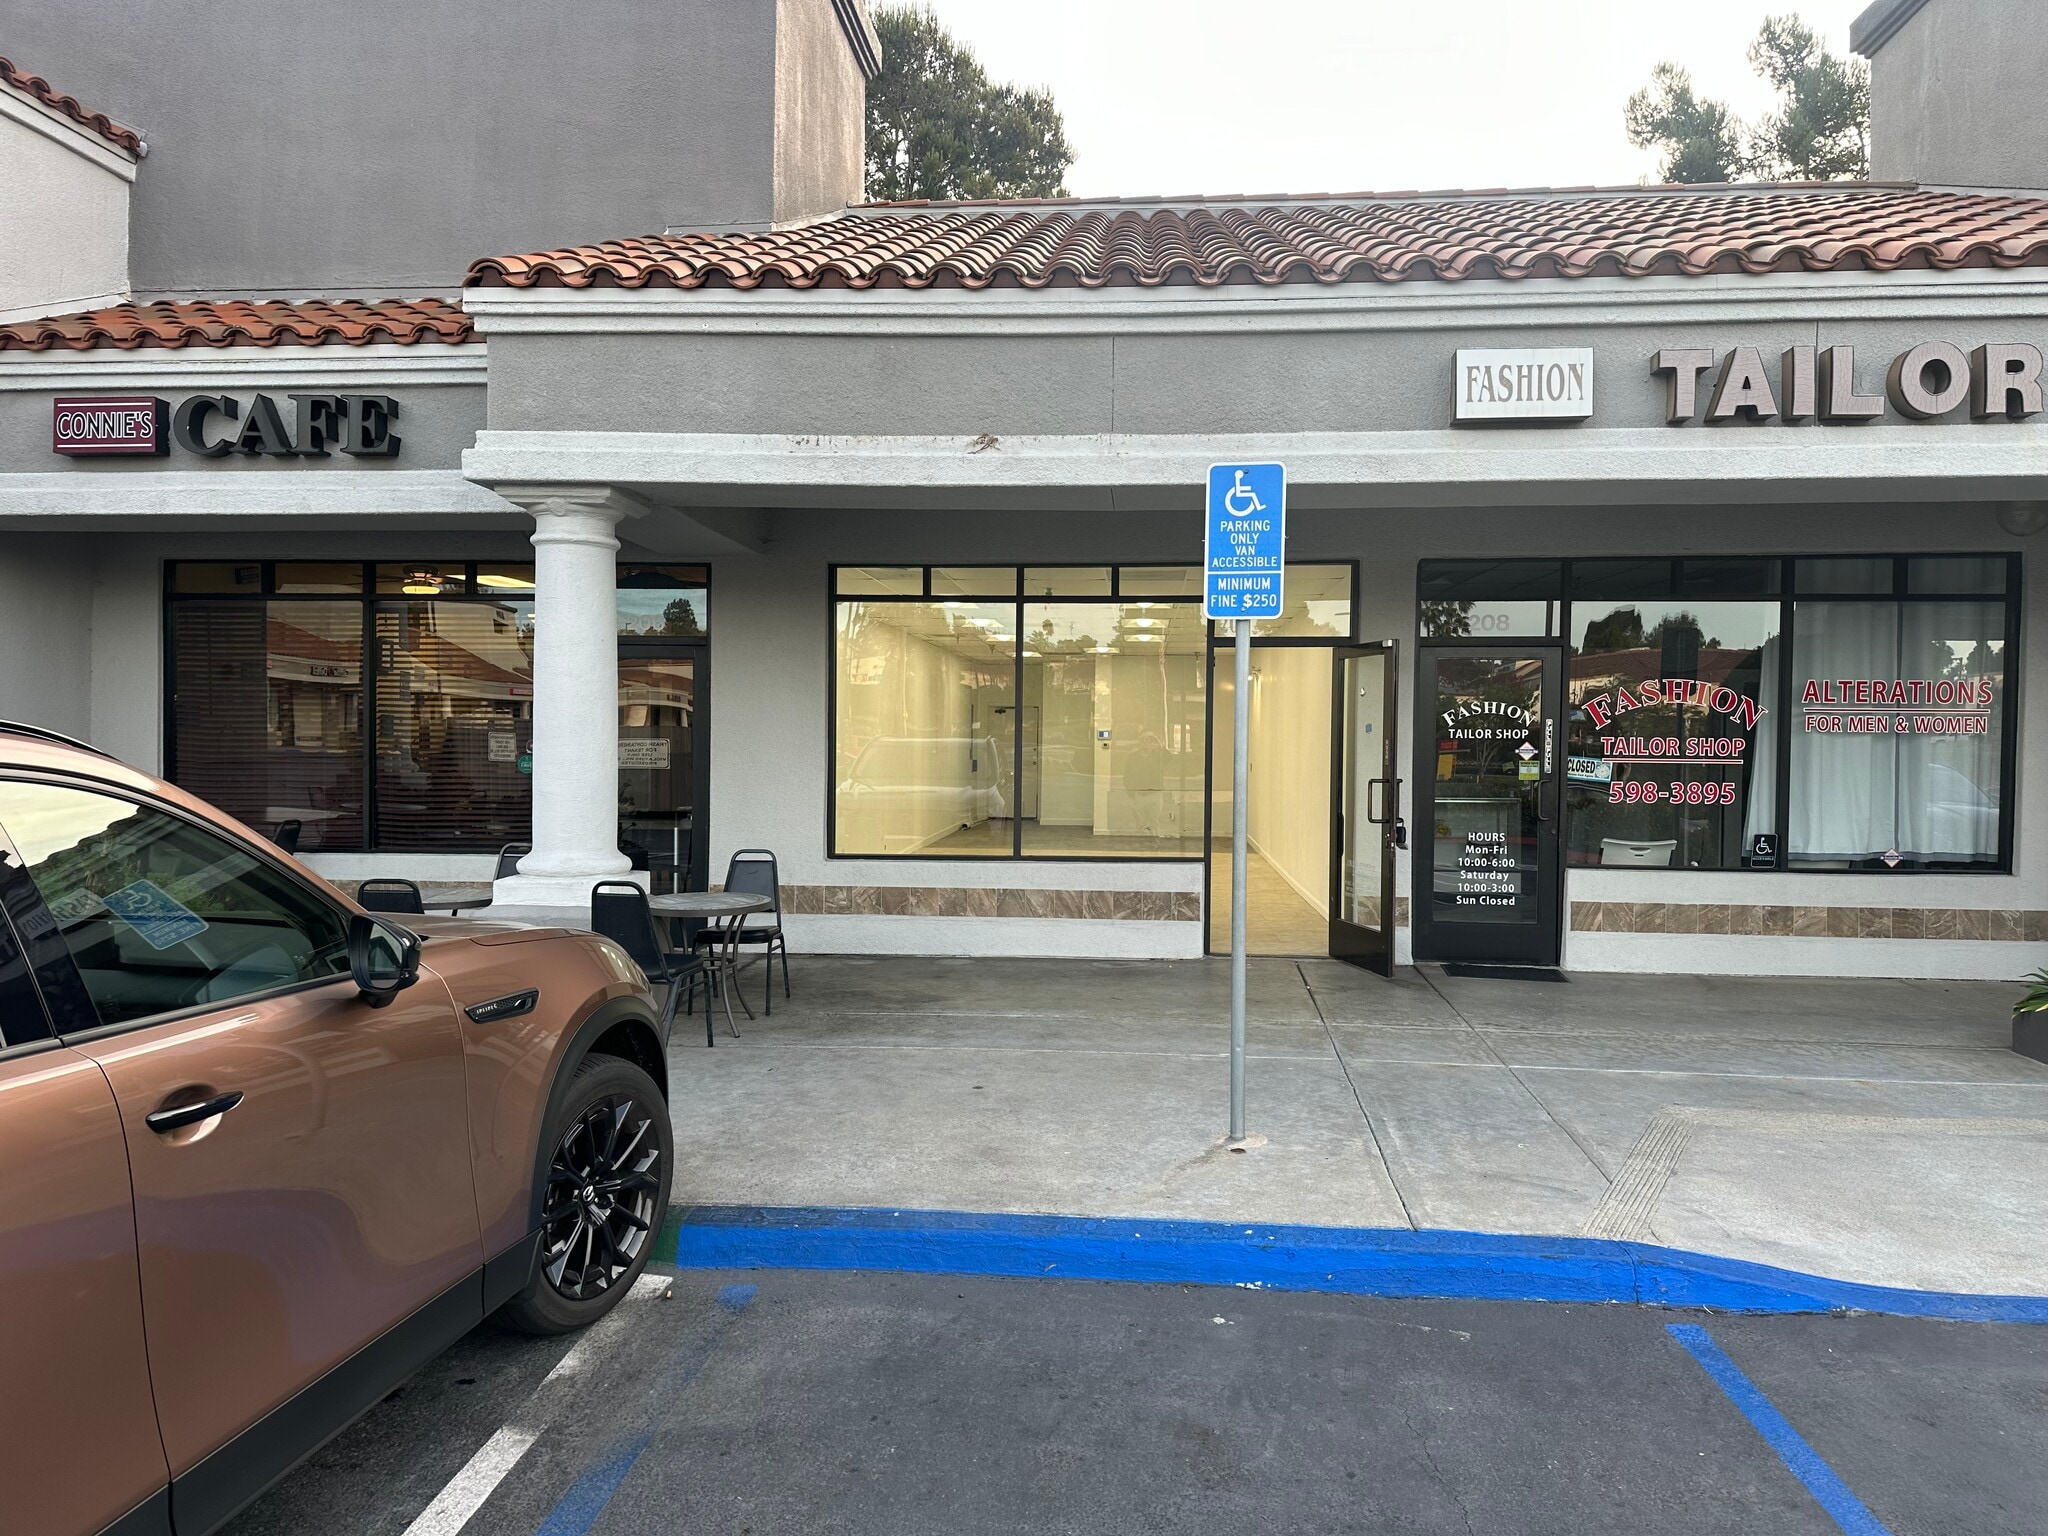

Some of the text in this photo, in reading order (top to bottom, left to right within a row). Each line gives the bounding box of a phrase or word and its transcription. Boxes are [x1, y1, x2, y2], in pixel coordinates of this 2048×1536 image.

[1465, 363, 1585, 404] FASHION
[1652, 340, 2044, 423] TAILOR
[56, 410, 153, 439] CONNIE'S
[173, 393, 401, 458] CAFE
[1220, 520, 1271, 532] PARKING
[1230, 533, 1260, 545] ONLY
[1235, 545, 1256, 556] VAN
[1212, 556, 1278, 568] ACCESSIBLE
[1217, 577, 1271, 591] MINIMUM
[1210, 593, 1277, 609] FINE $250
[1469, 614, 1511, 631] 208
[1801, 679, 1993, 705] ALTERATIONS
[1581, 678, 1769, 731] FASHION
[1441, 700, 1537, 728] FASHION
[1805, 715, 1988, 734] FOR MEN & WOMEN
[1448, 728, 1529, 740] TAILOR SHOP
[1600, 736, 1746, 757] TAILOR SHOP
[1567, 758, 1596, 774] CLOSED
[1608, 781, 1736, 805] 598-3895
[1468, 832, 1506, 842] HOURS
[1465, 845, 1508, 855] Mon-Fri
[1458, 857, 1515, 868] 10:00-6:00
[1460, 870, 1509, 882] Saturday
[1457, 883, 1515, 893] 10:00-3:00
[1456, 895, 1516, 906] Sun Closed
